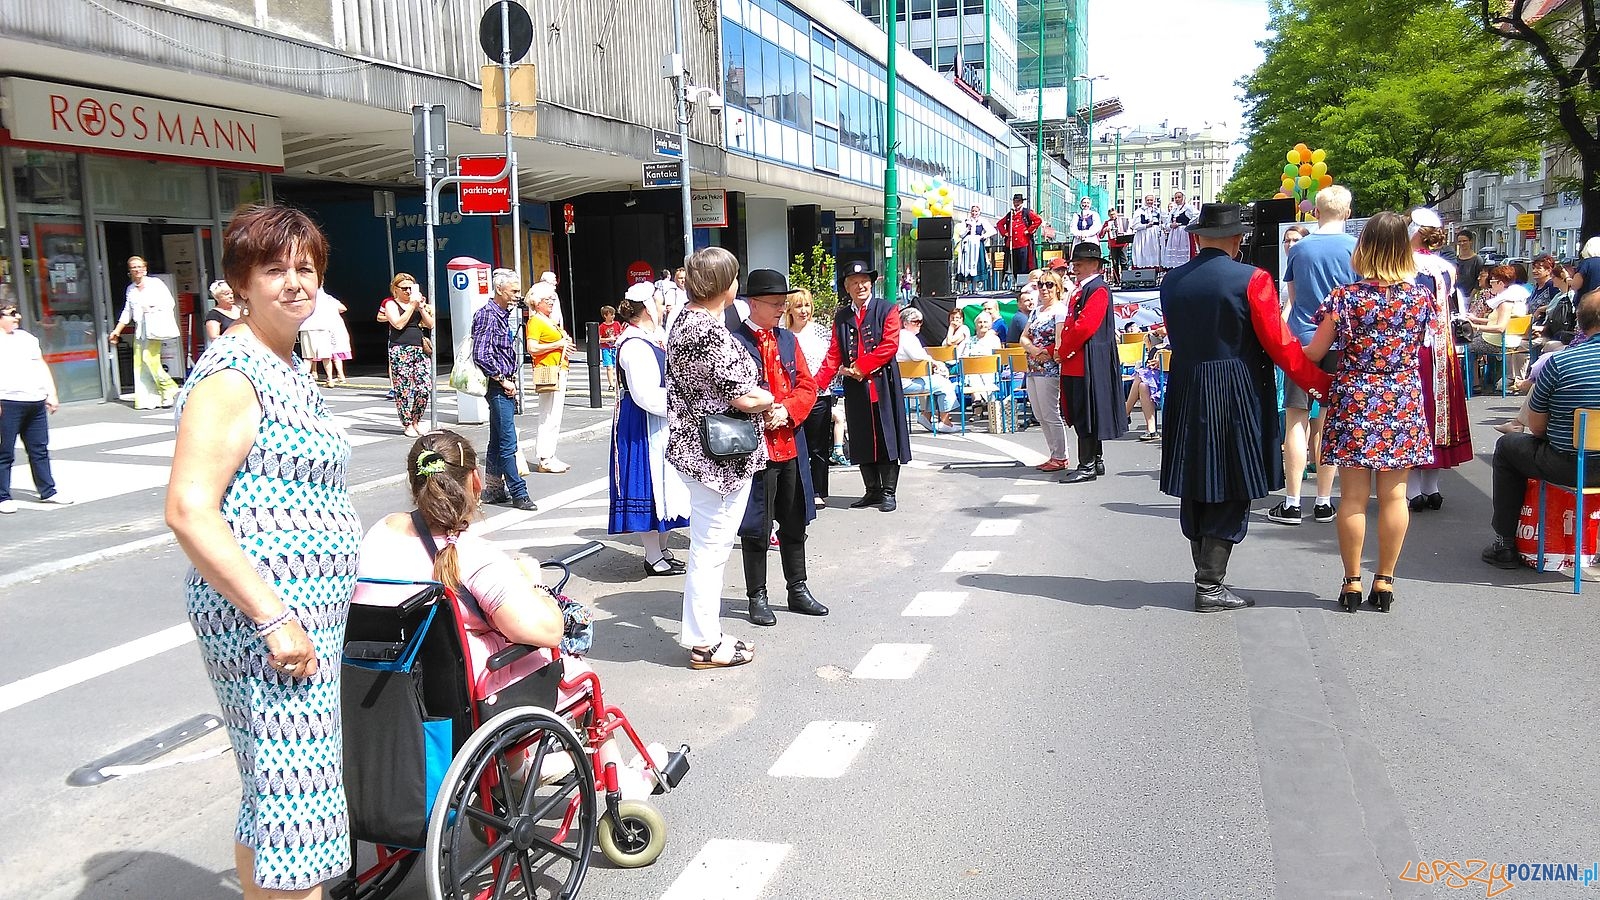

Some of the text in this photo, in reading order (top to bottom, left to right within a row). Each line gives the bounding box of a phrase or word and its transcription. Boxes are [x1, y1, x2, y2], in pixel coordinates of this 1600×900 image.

[49, 94, 257, 153] ROSSMANN
[646, 170, 678, 179] Kantaka
[463, 186, 508, 196] parkingowy
[396, 212, 463, 229] ŚWIŁO
